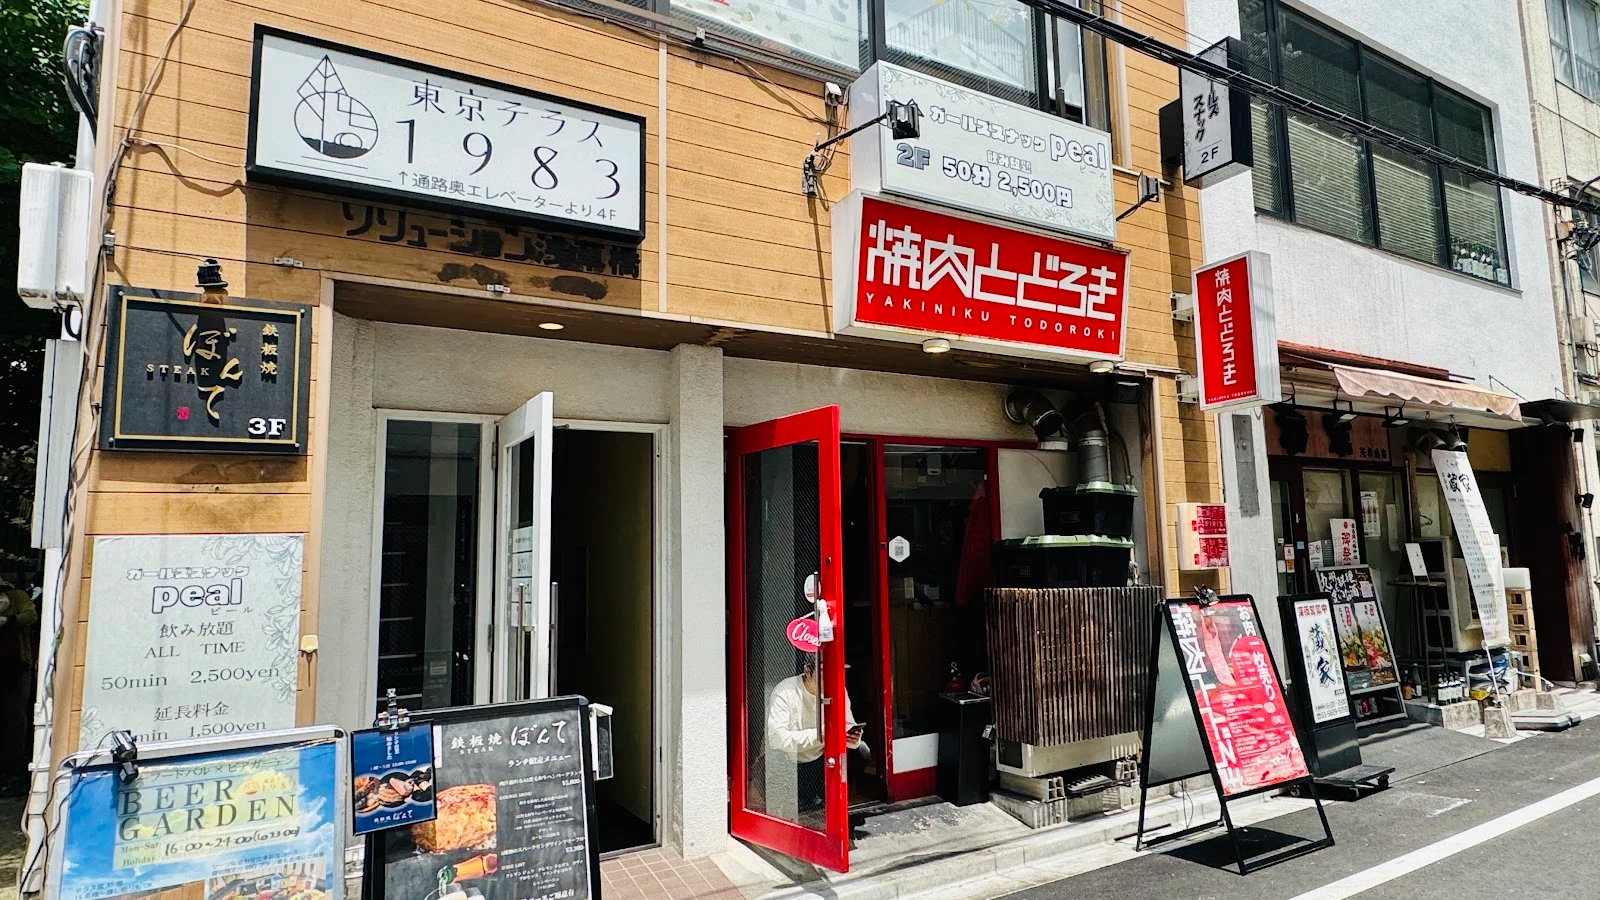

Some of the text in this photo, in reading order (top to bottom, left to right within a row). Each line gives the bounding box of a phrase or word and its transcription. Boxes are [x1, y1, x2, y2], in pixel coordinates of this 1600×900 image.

[408, 79, 604, 148] 東京テラス
[929, 104, 1106, 171] ガールズスナック peal
[395, 119, 621, 200] 1983
[896, 142, 930, 170] 2F
[1201, 146, 1219, 164] 2F
[942, 155, 1073, 208] 50分 2,500円
[866, 218, 1118, 321] 焼肉とどろき
[866, 292, 1116, 341] YAKINIKU TODOROKI
[1214, 268, 1237, 386] 焼肉とどろき
[260, 323, 280, 375] 鉄板焼
[146, 364, 210, 376] STEAK
[182, 324, 244, 420] ぼんて
[248, 417, 286, 436] 3F
[126, 566, 249, 581] ガールズスナック
[152, 578, 242, 614] peal
[159, 620, 234, 638] 飲み放題
[144, 641, 246, 659] ALL TIME
[101, 667, 280, 690] 50min 2,500yen
[154, 701, 229, 722] 延長料金
[188, 721, 266, 738] 1,500yen
[451, 720, 567, 750] 鉄板焼 ぼんて
[460, 746, 494, 755] STEAK
[150, 767, 210, 783] フードバル
[228, 756, 295, 773] ビアガーデン
[122, 779, 233, 816] BEER
[119, 794, 296, 841] GARDEN
